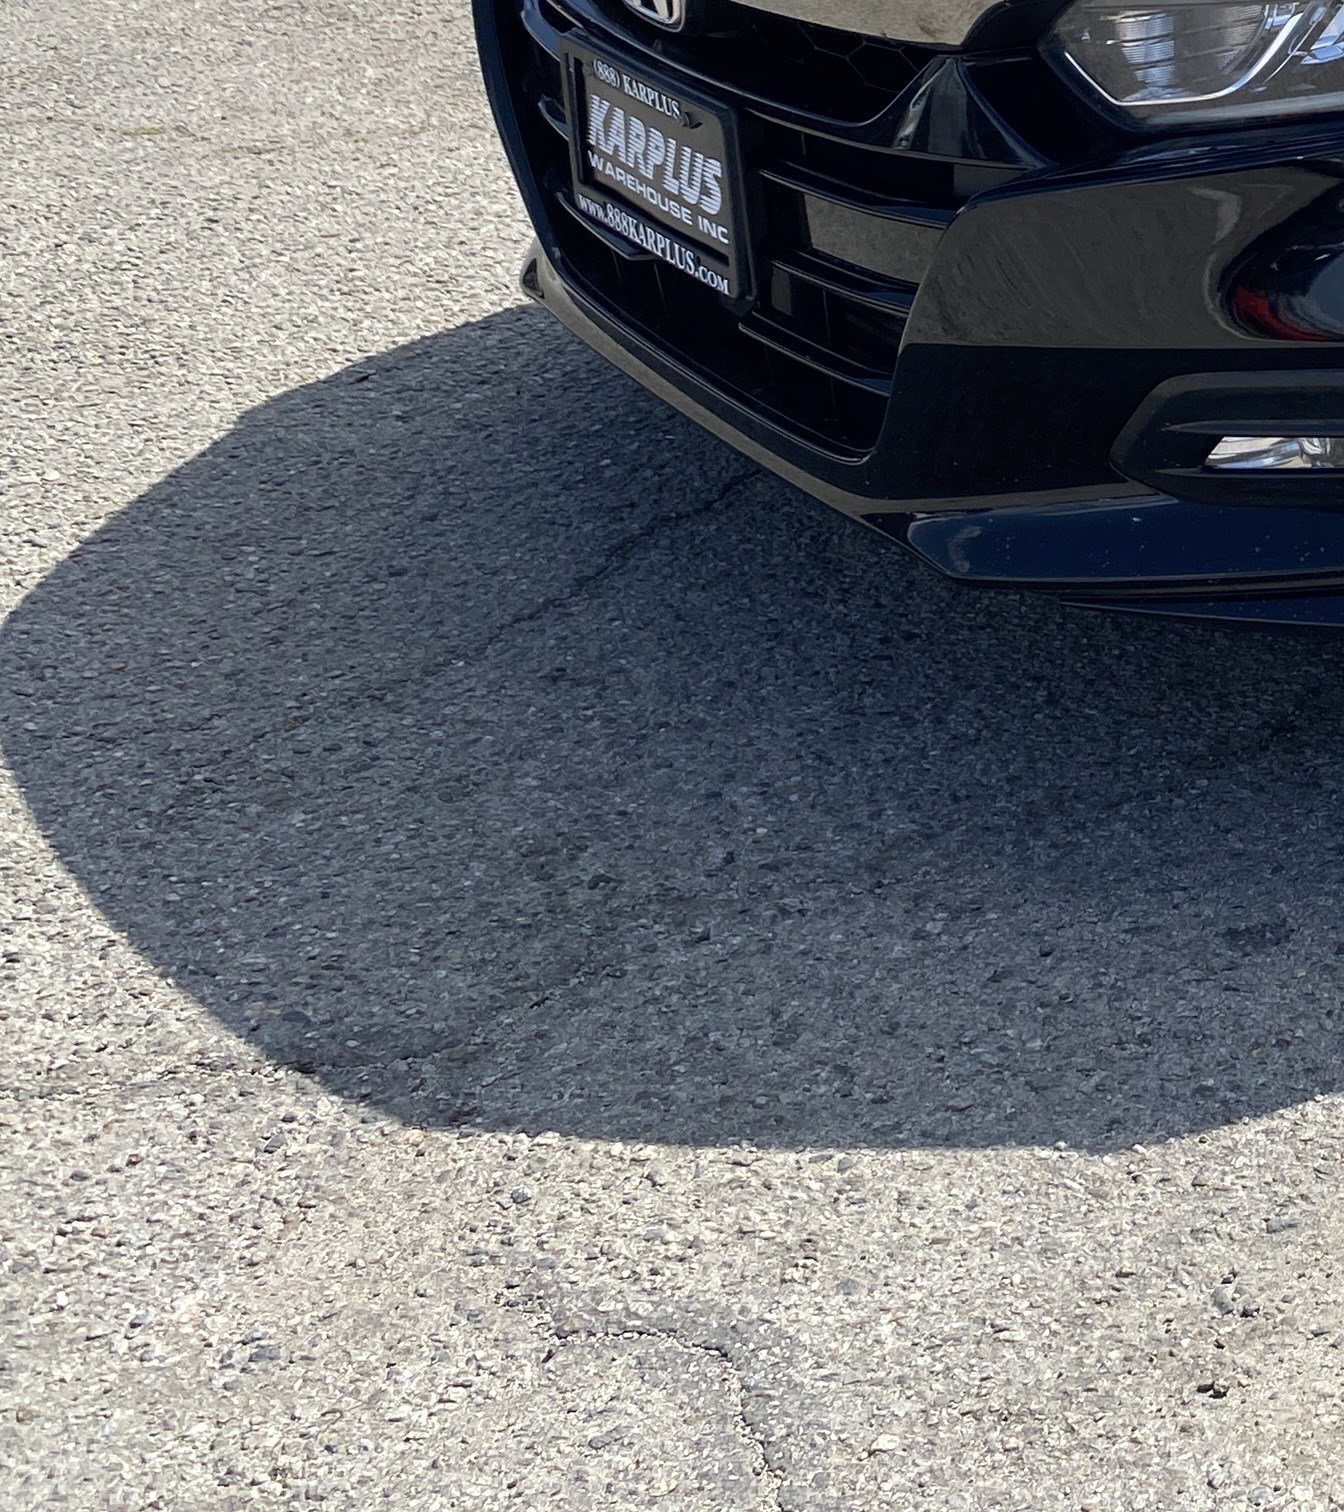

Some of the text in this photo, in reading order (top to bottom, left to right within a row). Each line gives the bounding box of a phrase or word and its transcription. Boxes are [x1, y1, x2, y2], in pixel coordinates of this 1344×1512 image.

[593, 58, 681, 121] (888) KARPLUS
[587, 92, 723, 216] KARPLUS
[587, 149, 730, 245] WAREHOUSE INC
